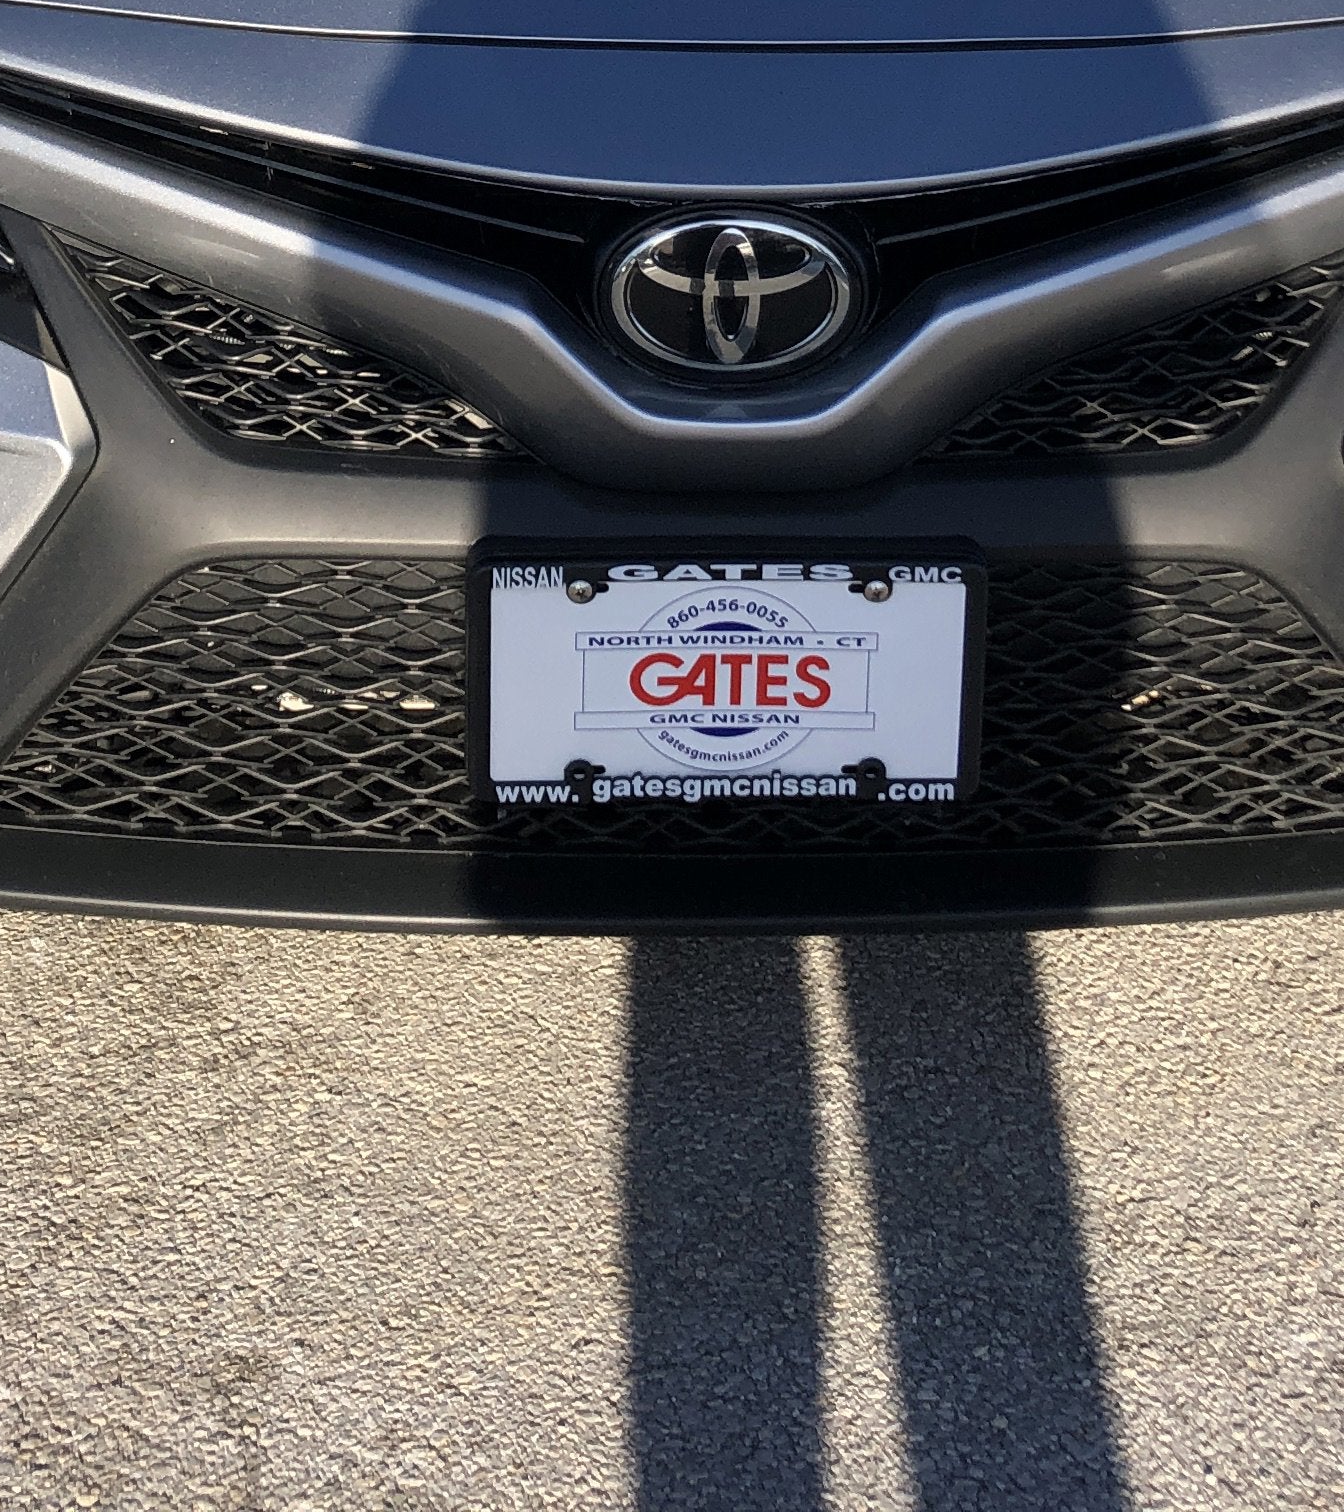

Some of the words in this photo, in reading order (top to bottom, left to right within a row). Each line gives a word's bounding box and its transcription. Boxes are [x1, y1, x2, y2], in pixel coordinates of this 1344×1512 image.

[492, 566, 565, 589] NISSAN
[608, 564, 854, 581] GATES
[888, 565, 963, 583] GMC
[666, 598, 789, 630] 860-456-0055
[587, 635, 674, 647] NORTH
[678, 634, 805, 647] WINDHAM
[836, 636, 868, 647] CT
[628, 652, 832, 709] GATES
[649, 712, 705, 725] GMC
[711, 713, 801, 725] NISSAN
[657, 728, 790, 763] gatesgmcnissan.com
[495, 784, 579, 804] www.
[592, 772, 857, 804] gatesgmcnissan
